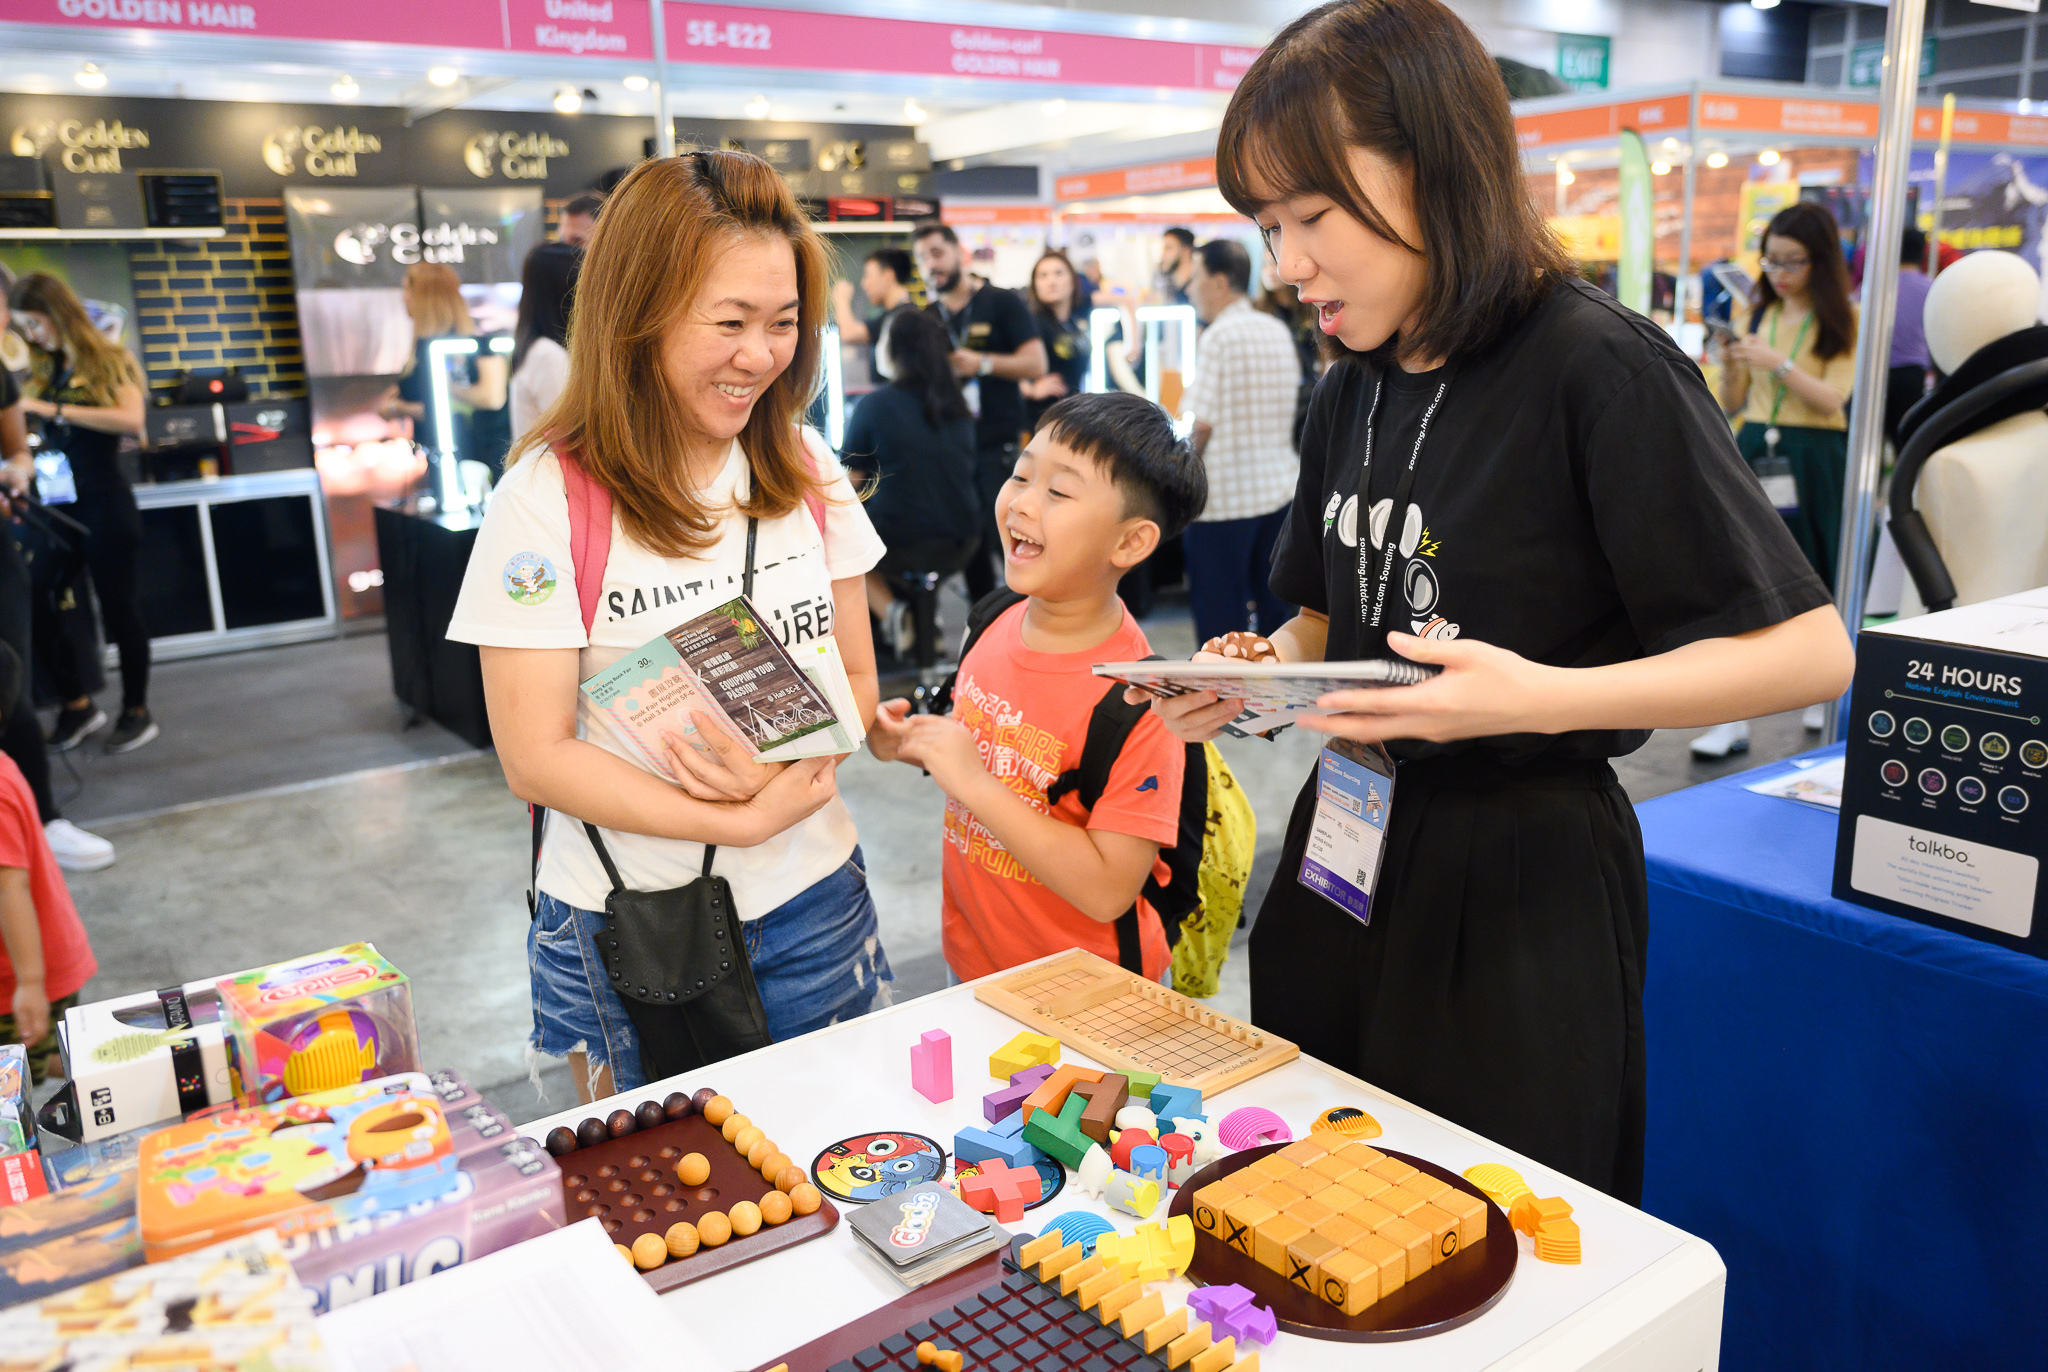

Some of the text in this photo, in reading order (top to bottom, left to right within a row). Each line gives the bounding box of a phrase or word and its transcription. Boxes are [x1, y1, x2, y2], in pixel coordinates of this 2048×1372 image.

[58, 0, 257, 29] GOLDEN HAIR
[544, 0, 614, 23] United
[535, 24, 628, 54] Kingdom
[686, 20, 772, 50] 5E-E22
[1408, 382, 1446, 471] sourcing.hktdc.com
[1370, 542, 1397, 627] hktdc.com Sourcing
[591, 686, 603, 696] Hong
[602, 680, 614, 690] Kong
[612, 673, 623, 682] Book
[623, 667, 632, 676] Fair
[718, 661, 776, 691] EQUIPPING YOUR
[1906, 659, 2022, 696] 24 HOURS
[629, 683, 690, 722] Book Fair Highlights
[725, 681, 759, 701] PASSION
[772, 691, 787, 700] Hall
[1904, 681, 2020, 708] Native English Environment
[643, 713, 656, 724] Hall
[667, 698, 681, 708] Hall
[680, 690, 695, 701] 5F-G
[1963, 786, 1979, 795] ABC
[2007, 796, 2020, 804] 123
[1908, 835, 1968, 863] talkbo
[1304, 868, 1347, 901] EXHIBITOR
